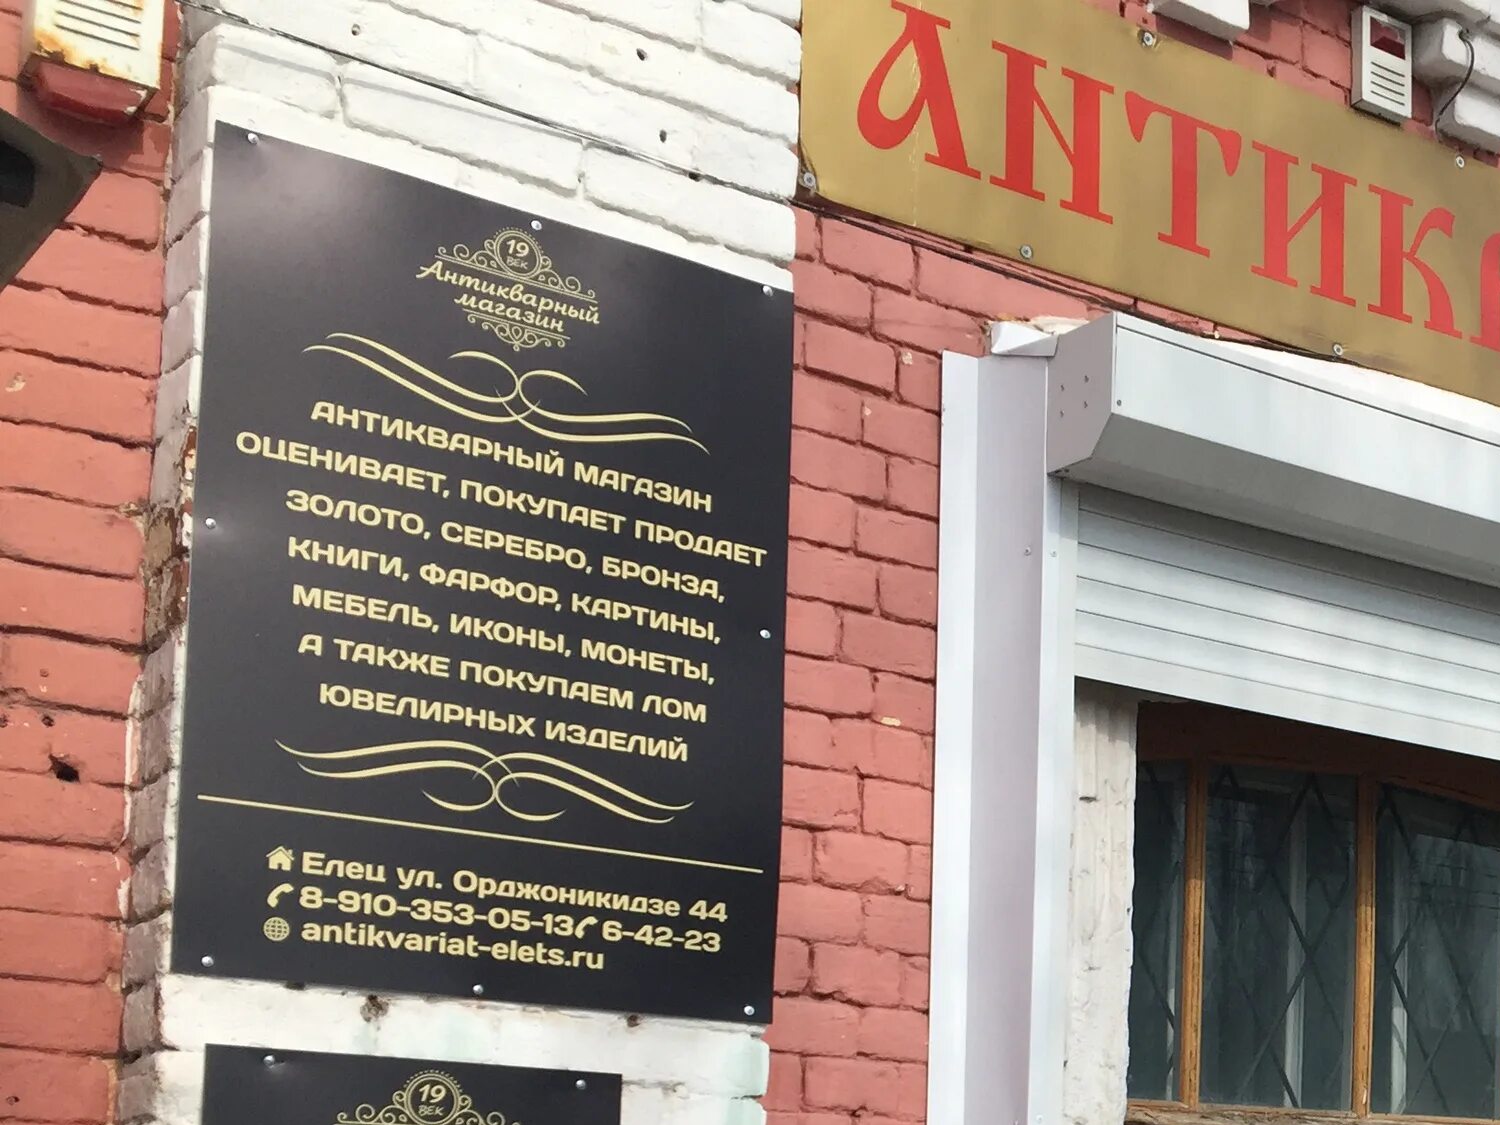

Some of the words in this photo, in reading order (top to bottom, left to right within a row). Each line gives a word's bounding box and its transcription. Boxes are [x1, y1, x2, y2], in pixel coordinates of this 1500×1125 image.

[506, 239, 529, 257] 19
[506, 256, 528, 270] ВЕК
[416, 260, 600, 324] Антикварный
[454, 293, 564, 332] магазин
[310, 401, 565, 477] АНТИКВАРНЫЙ
[574, 460, 713, 513] МАГАЗИН
[235, 431, 450, 498] ОЦЕНИВАЕТ,
[460, 479, 626, 534] ПОКУПАЕТ
[634, 519, 768, 568] ПРОДАЕТ
[286, 489, 431, 541] ЗОЛОТО,
[441, 521, 593, 574] СЕРЕБРО,
[602, 556, 726, 604] БРОНЗА,
[288, 537, 409, 582] КНИГИ,
[419, 562, 562, 612] ФАРФОР,
[571, 594, 722, 646] КАРТИНЫ,
[292, 584, 440, 634] МЕБЕЛЬ,
[449, 614, 572, 658] ИКОНЫ,
[581, 639, 716, 686] МОНЕТЫ,
[298, 633, 323, 657] А
[333, 638, 450, 679] ТАКЖЕ
[460, 660, 634, 711] ПОКУПАЕМ
[641, 693, 708, 723] ЛОМ
[319, 683, 535, 738] ЮВЕЛИРНЫХ
[545, 720, 689, 762] ИЗДЕЛИЙ
[299, 886, 575, 937] 8-910-353-05-13
[601, 920, 722, 954] 6-42-23
[301, 851, 386, 884] Елец
[396, 866, 443, 891] ул.
[453, 869, 681, 918] Орджоникидзе
[689, 900, 729, 924] 44
[300, 919, 605, 972] antikvariat-elets.ru
[418, 1084, 447, 1103] 19
[418, 1103, 445, 1116] ВЕК
